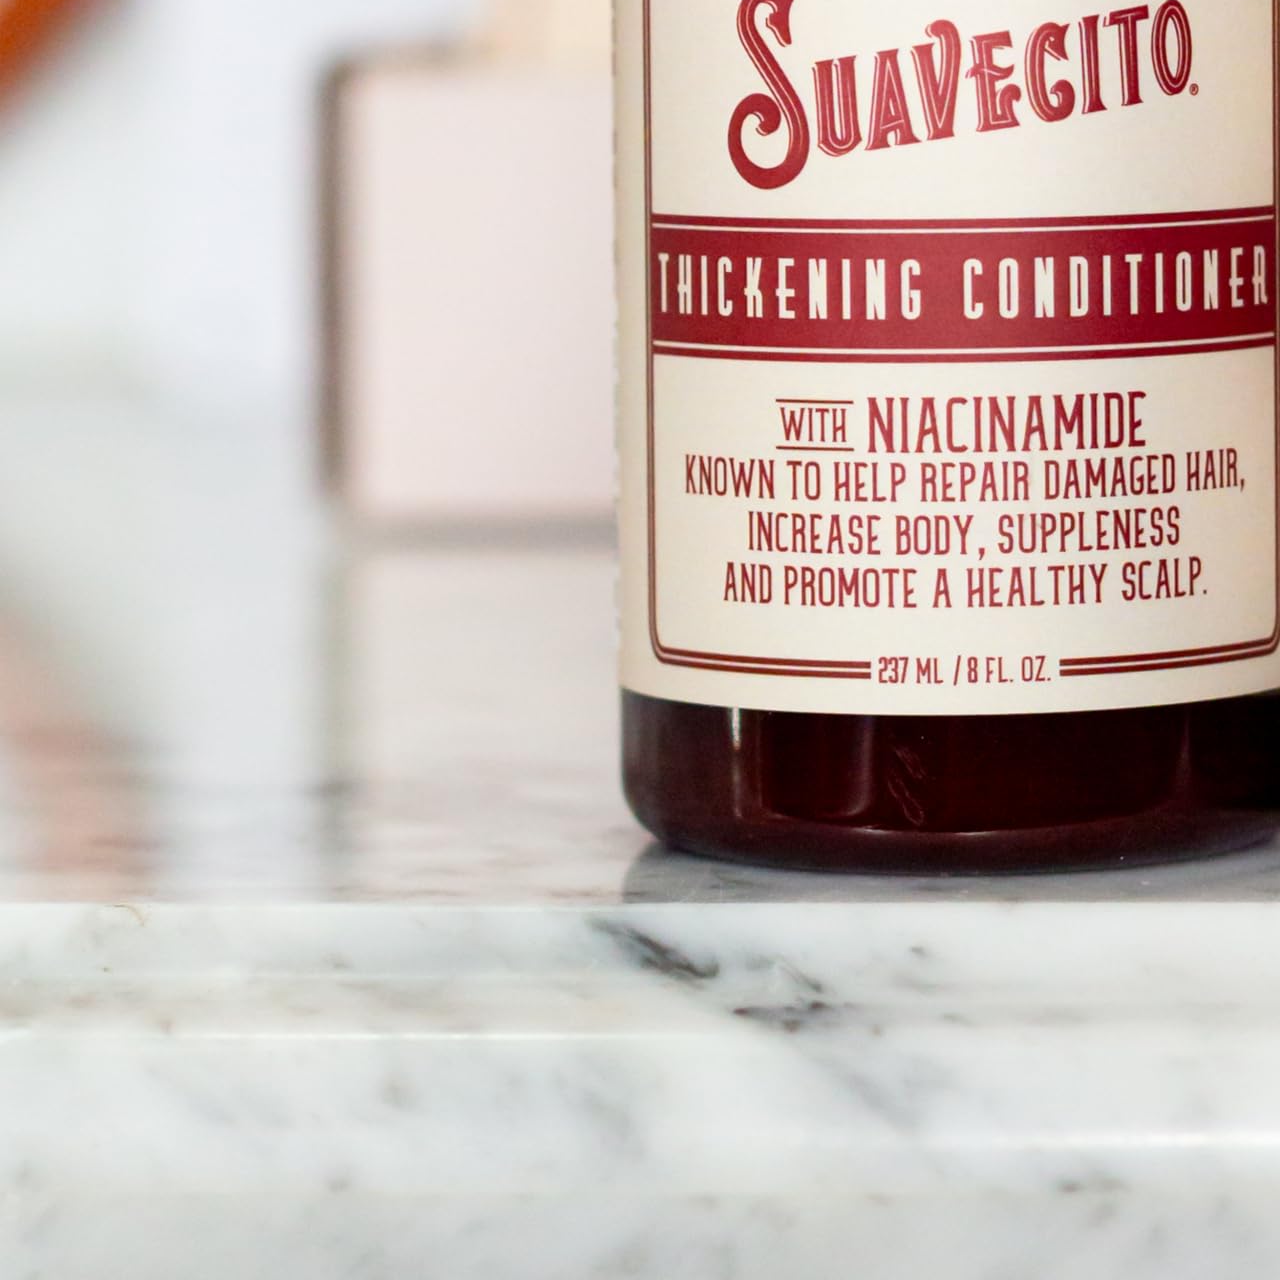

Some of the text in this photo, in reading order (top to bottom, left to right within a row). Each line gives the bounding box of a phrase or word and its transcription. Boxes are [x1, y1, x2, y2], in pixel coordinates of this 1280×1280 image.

[658, 245, 1269, 321] THICKENING CONDITIONER
[780, 390, 1147, 454] WITH NIACINAMIDE
[684, 447, 1246, 504] KNOWN TO HELP REPAIR DAMAGED HAIR,
[747, 511, 882, 556] INCREASE
[997, 505, 1181, 554] SUPPLENESS
[722, 556, 1208, 609] AND PROMOTE A HEALTHY SCALP.
[877, 655, 909, 685] 237
[915, 656, 944, 685] ML
[966, 655, 979, 683] 8
[985, 656, 1014, 683] FL.
[1020, 655, 1051, 683] OZ.
